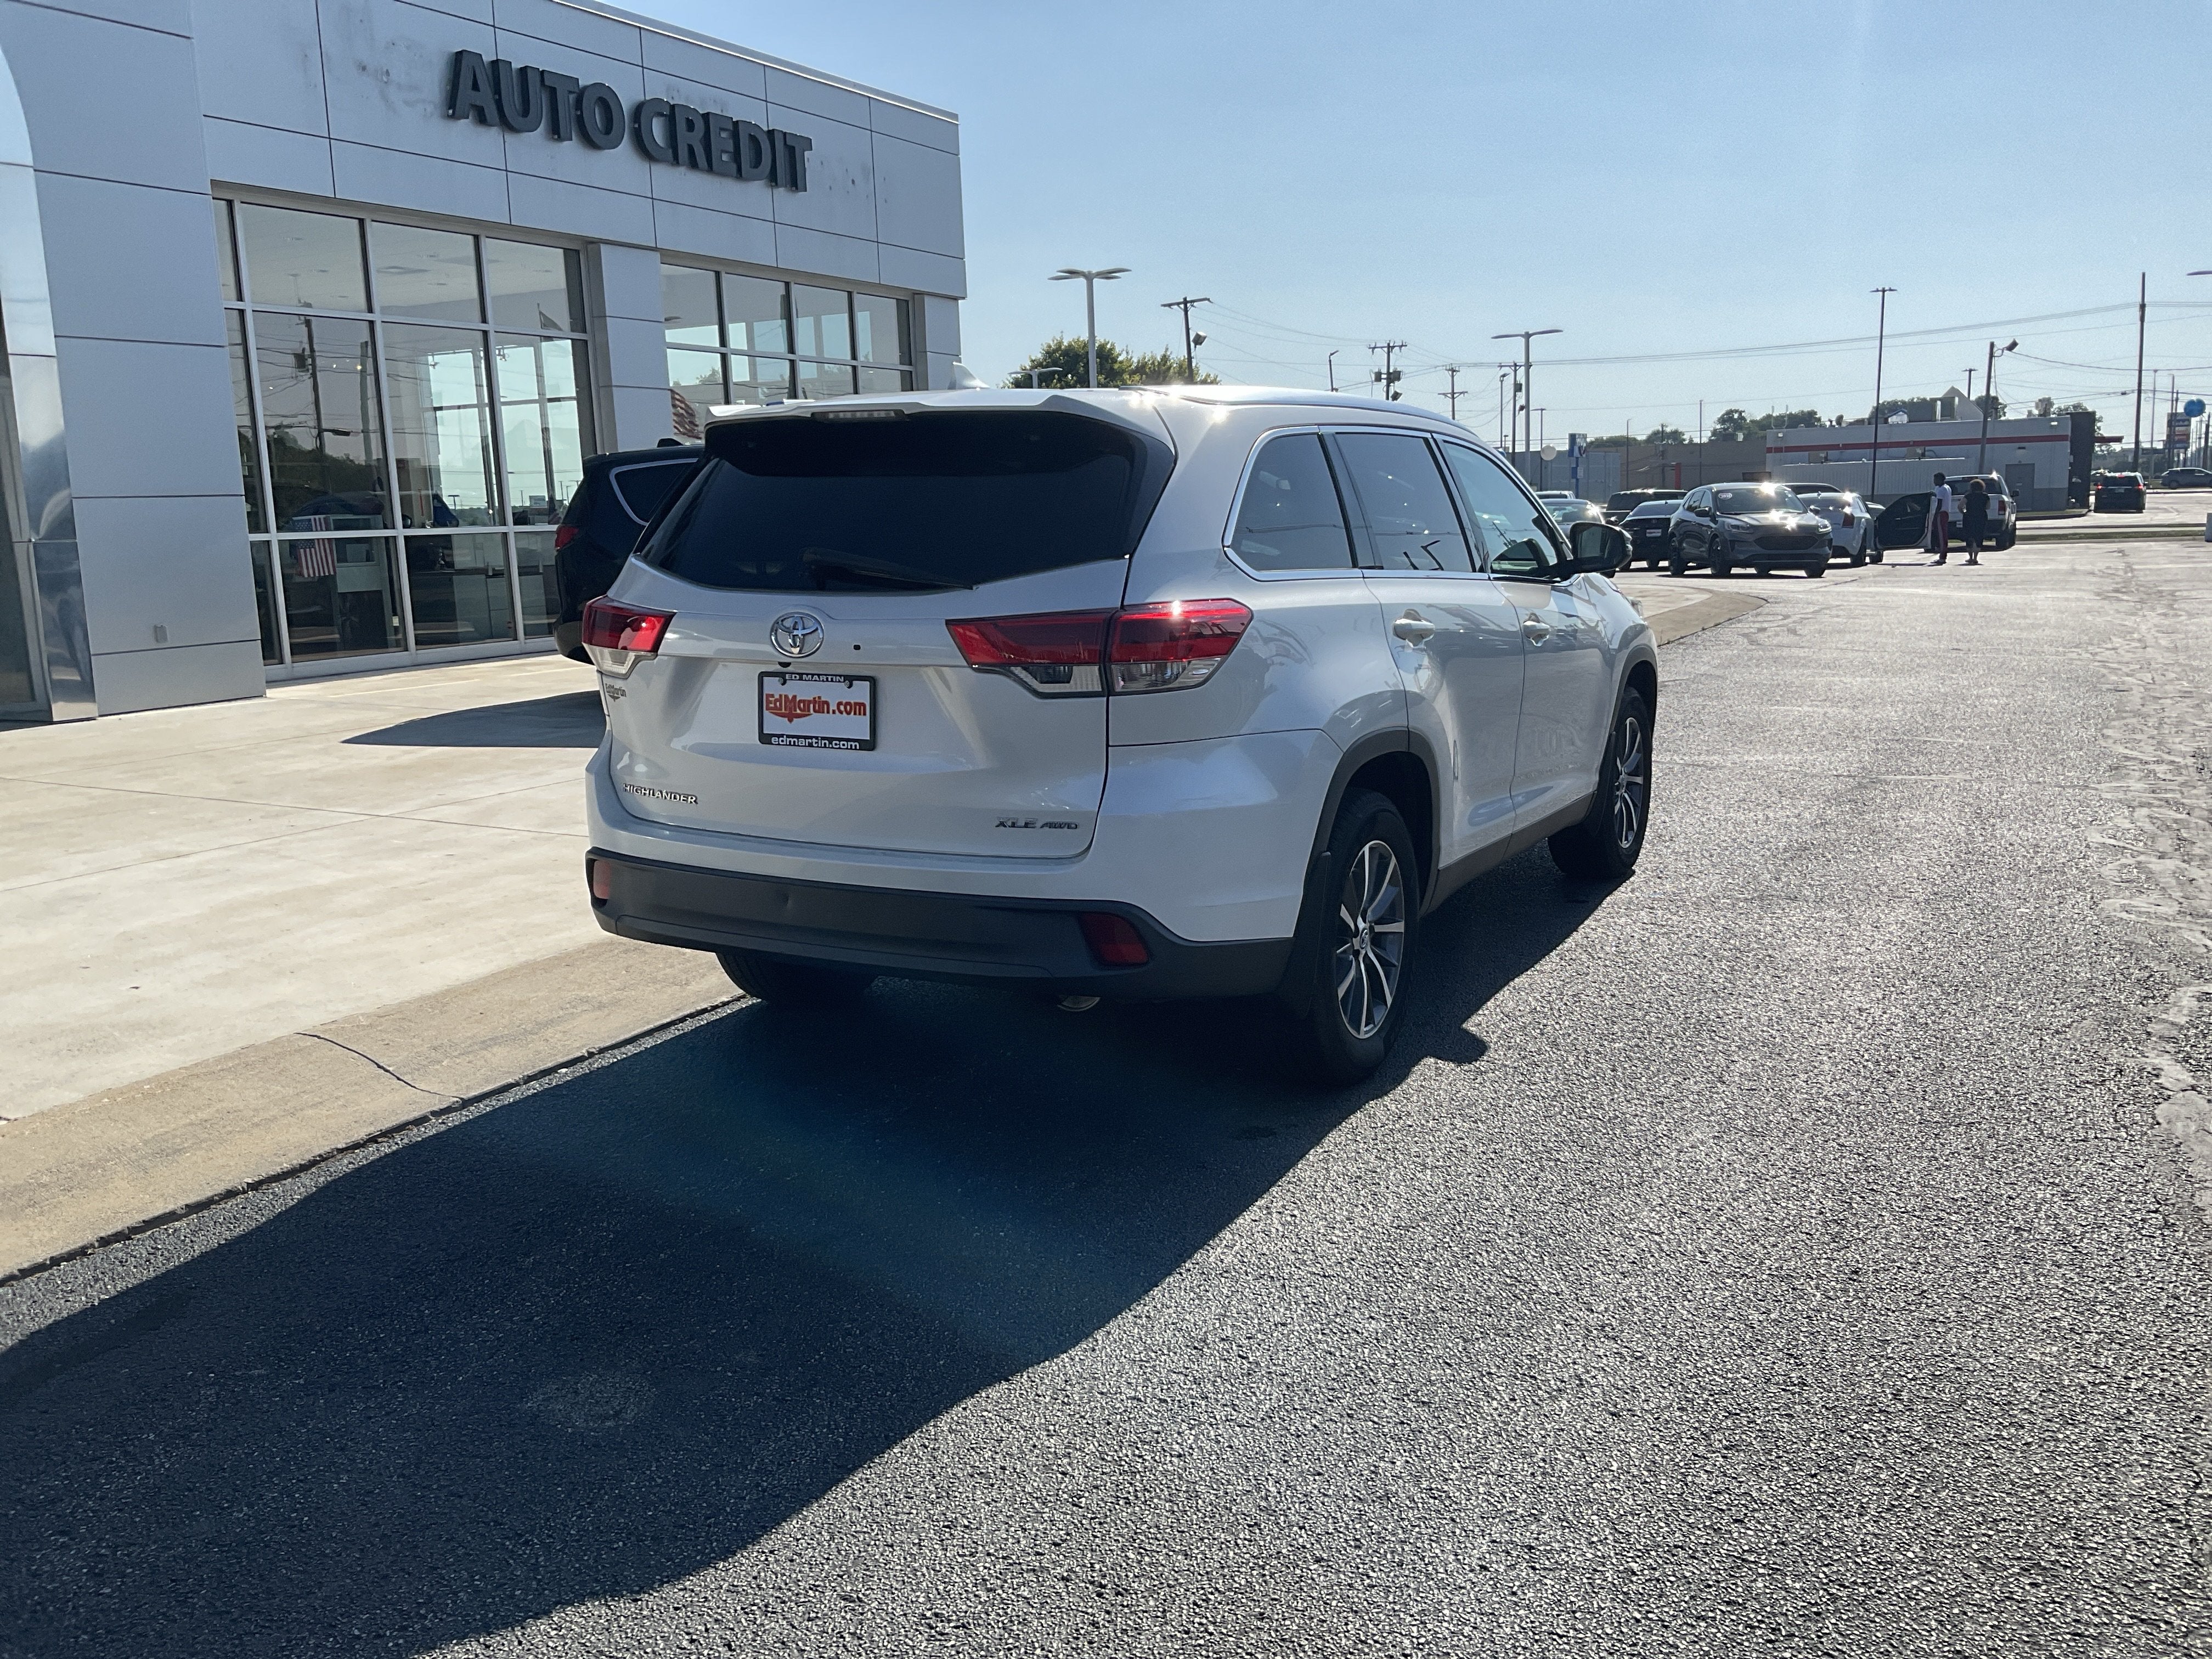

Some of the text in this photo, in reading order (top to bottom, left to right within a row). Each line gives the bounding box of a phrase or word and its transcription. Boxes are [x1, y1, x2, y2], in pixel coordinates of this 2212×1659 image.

[447, 49, 812, 192] AUTO CREDIT
[765, 693, 867, 716] EdMartin.com
[771, 735, 860, 749] edmartin.com
[623, 783, 698, 804] HIGHLANDER
[995, 816, 1079, 830] XLE AWD
